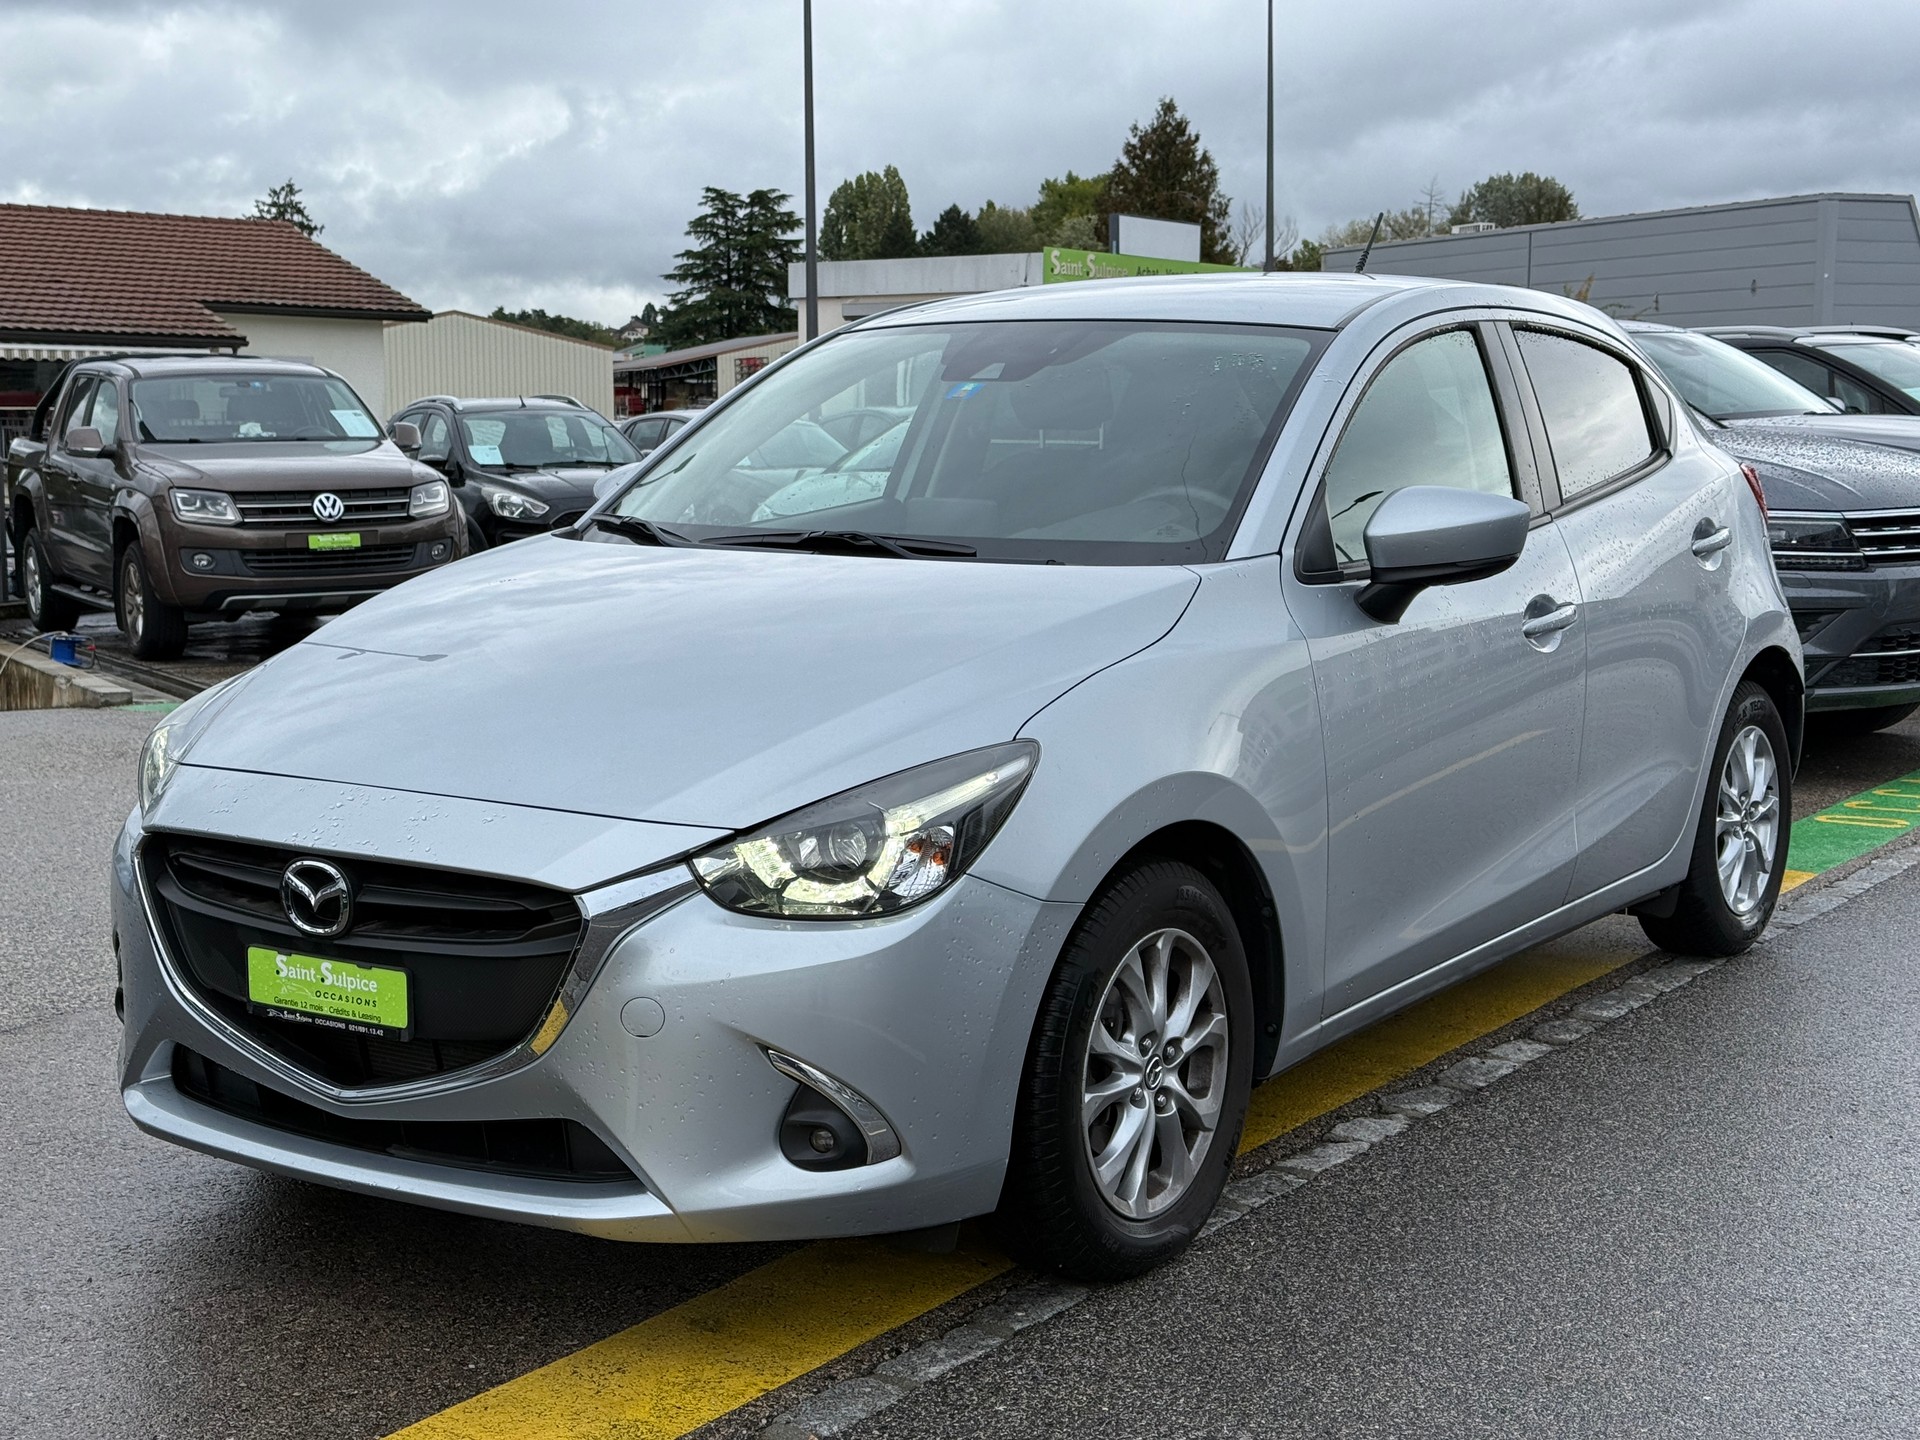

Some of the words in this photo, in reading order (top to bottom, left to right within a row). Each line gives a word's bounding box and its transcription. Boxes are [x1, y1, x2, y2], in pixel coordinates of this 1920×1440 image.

[275, 954, 378, 992] Saint-Sulpice
[274, 996, 299, 1007] Garantie
[300, 1001, 308, 1009] 12
[309, 1003, 324, 1012] mois
[328, 1006, 350, 1017] Crédits
[351, 1010, 357, 1018] &
[358, 1010, 382, 1023] Leasing
[315, 990, 378, 1008] OCCASIONS
[314, 1018, 346, 1030] OCCASIONS
